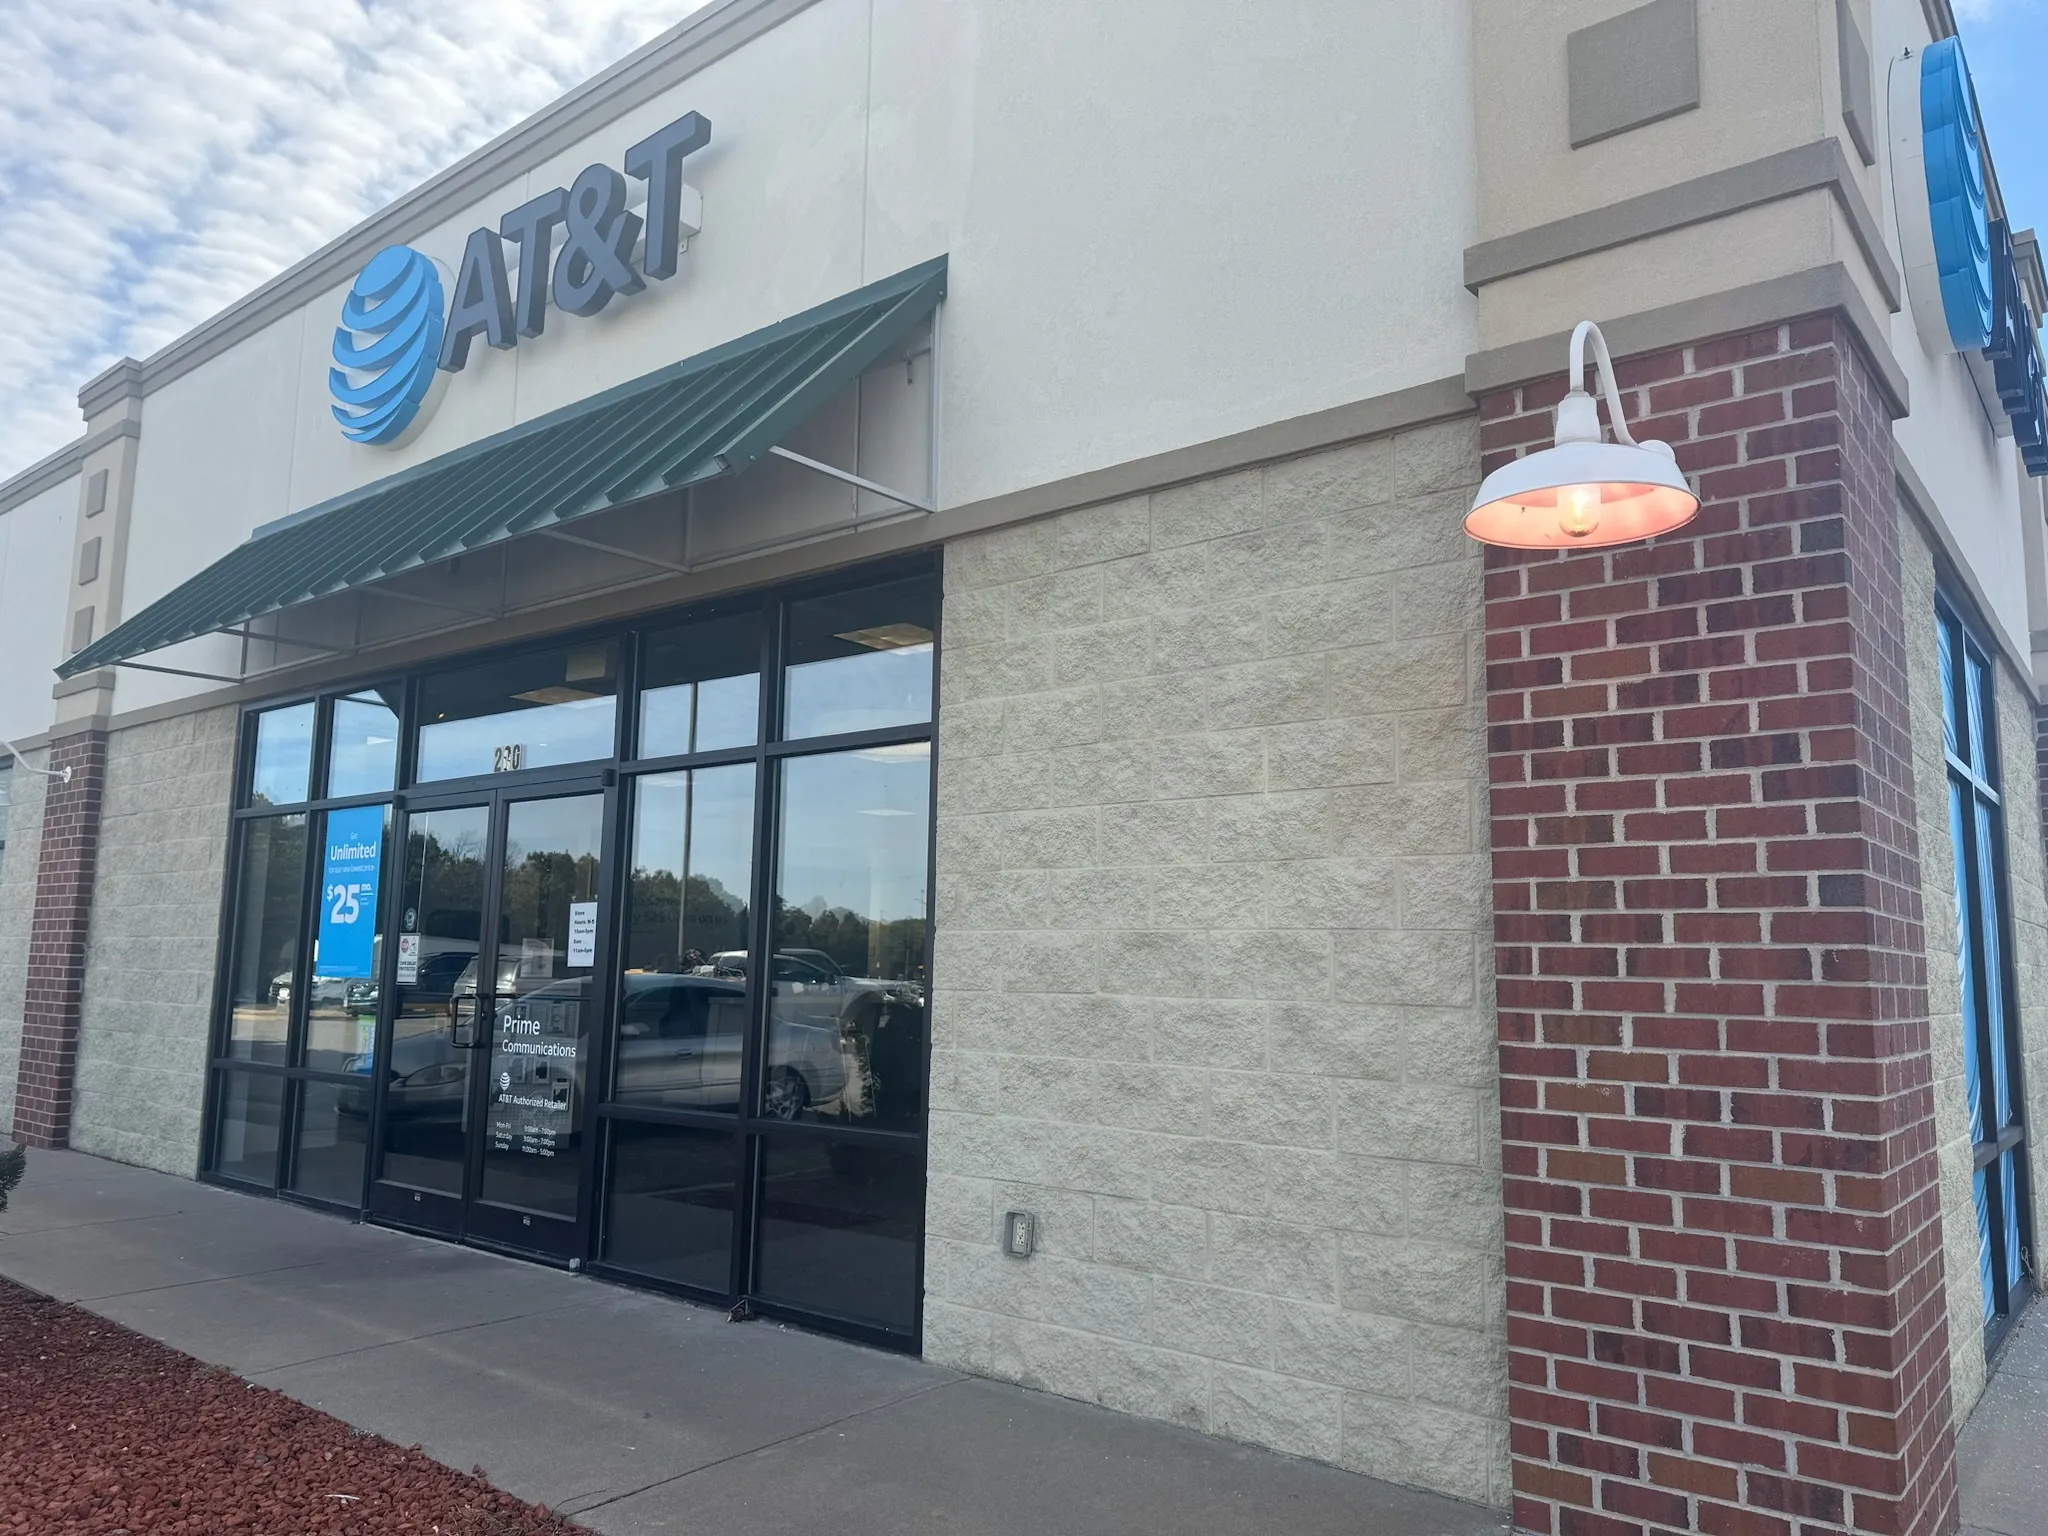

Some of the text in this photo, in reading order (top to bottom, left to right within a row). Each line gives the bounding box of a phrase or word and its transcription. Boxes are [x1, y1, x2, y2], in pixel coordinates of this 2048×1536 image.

[439, 110, 711, 373] AT&T
[330, 841, 377, 860] Unlimited
[327, 883, 360, 924] $25
[503, 1015, 540, 1035] Prime
[502, 1039, 576, 1057] Communications
[498, 1094, 567, 1110] AT&T Authorized Retailer
[495, 1131, 512, 1141] Saturday
[495, 1141, 509, 1151] Sunday
